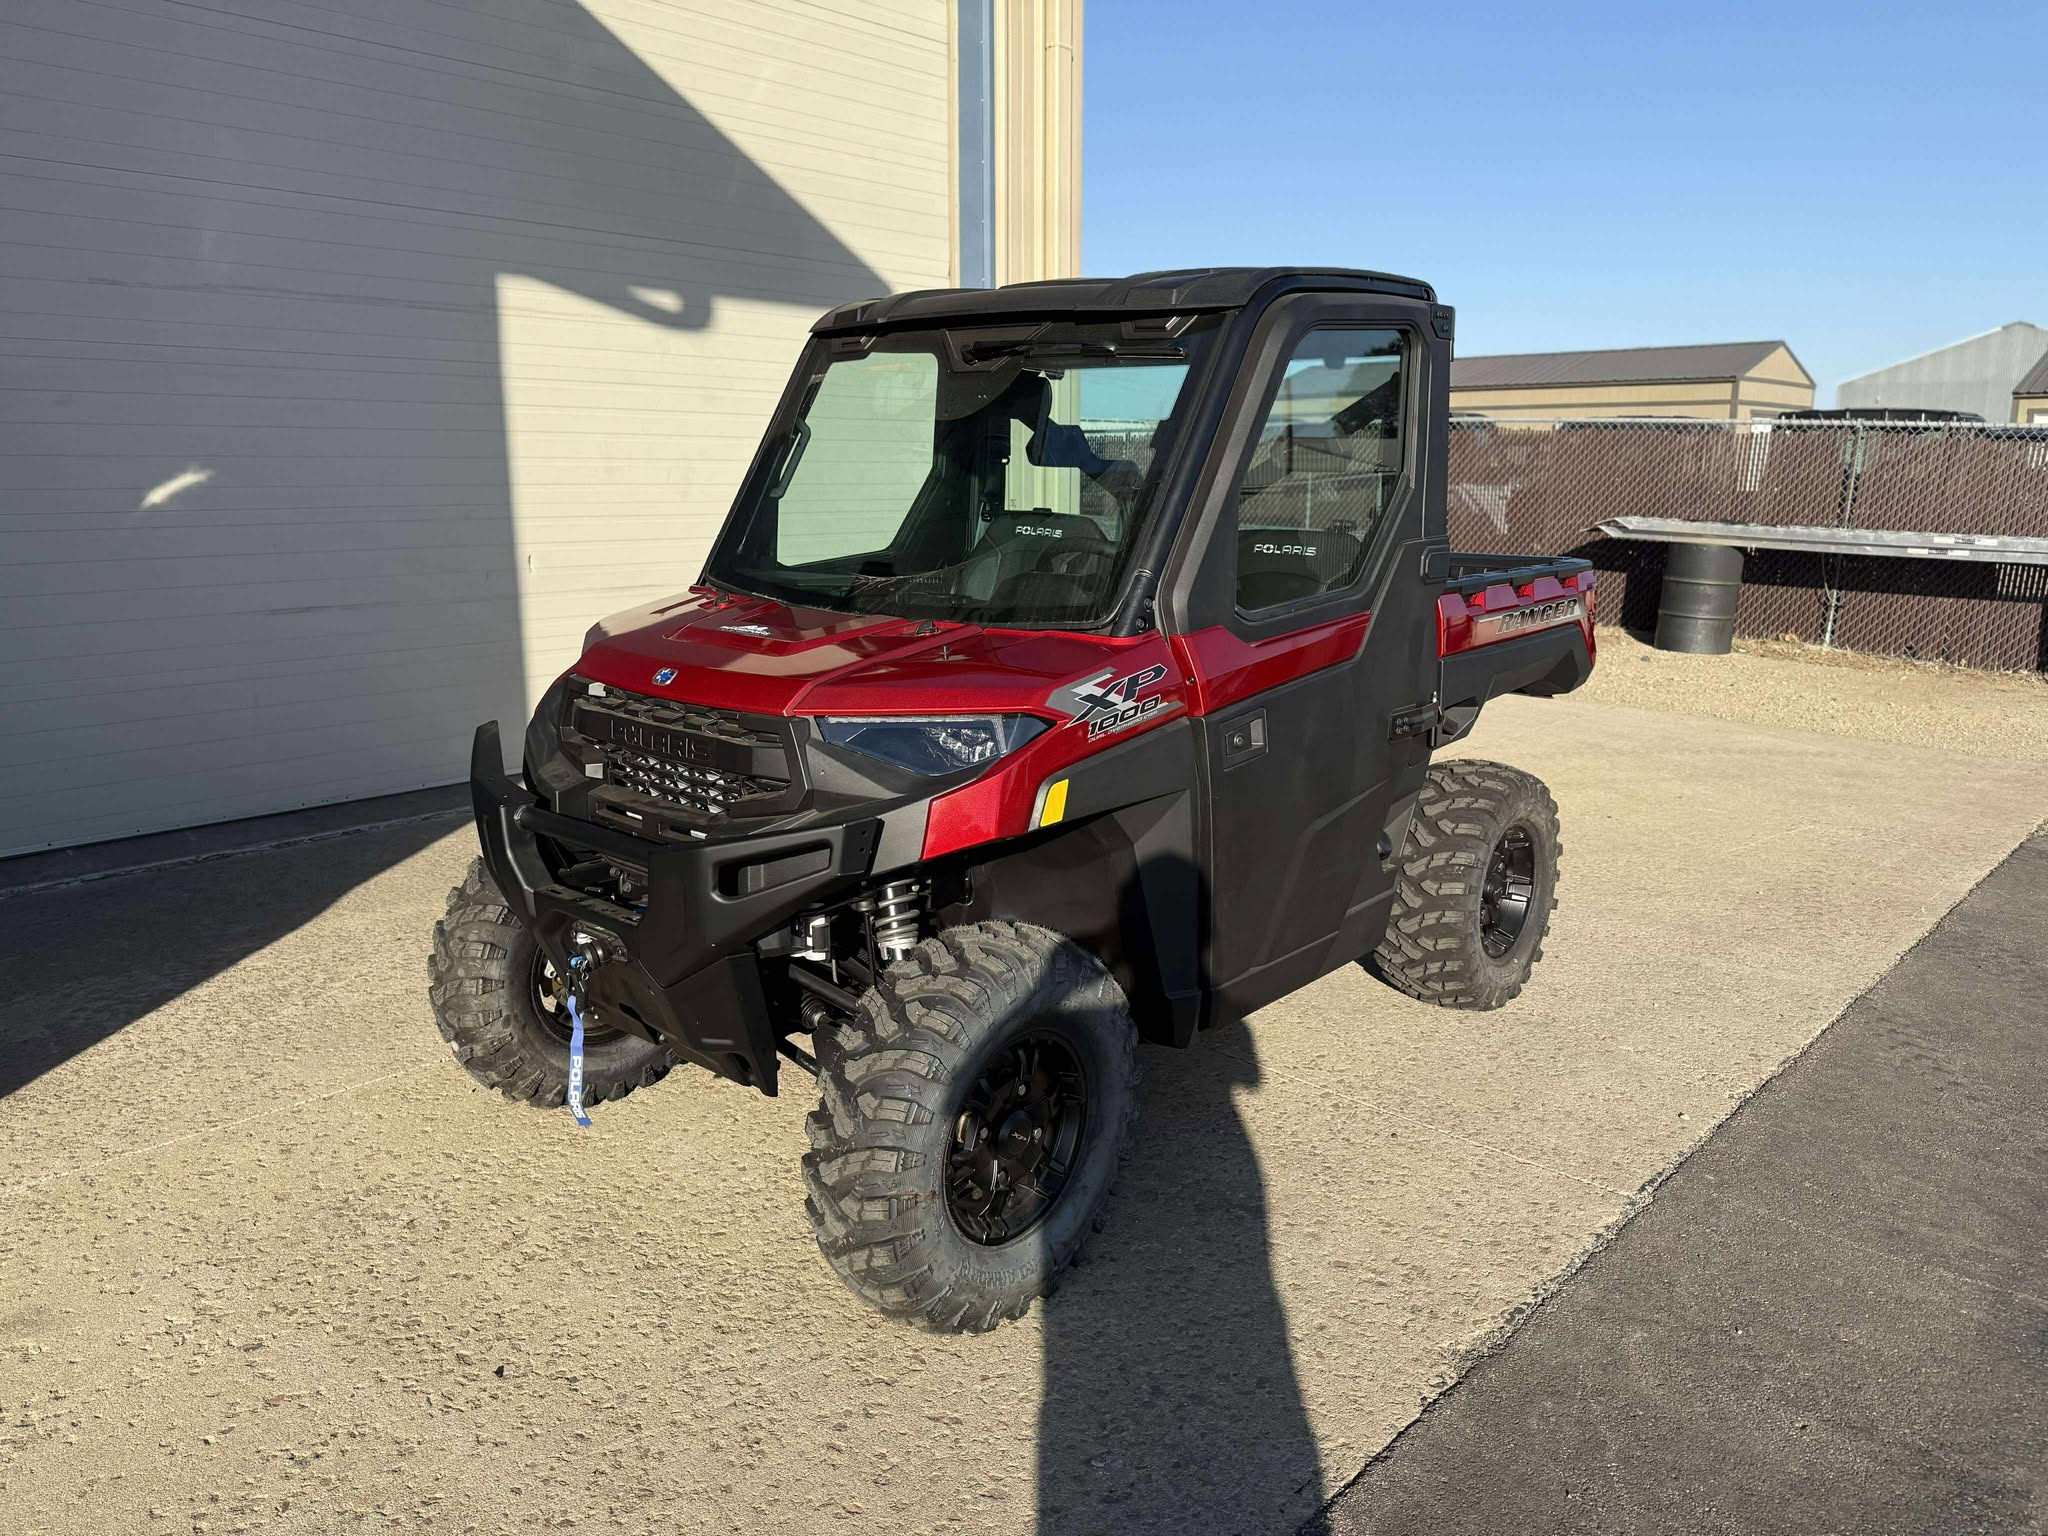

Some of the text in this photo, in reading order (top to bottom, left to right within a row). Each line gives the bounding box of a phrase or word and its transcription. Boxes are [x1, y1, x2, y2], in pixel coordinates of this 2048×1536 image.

[1015, 525, 1063, 538] POLARIS
[1253, 544, 1317, 557] POLARIS
[1496, 598, 1578, 635] RANGER
[1062, 663, 1168, 730] XP
[1087, 693, 1162, 738] 1000
[570, 1055, 586, 1119] POLARIS
